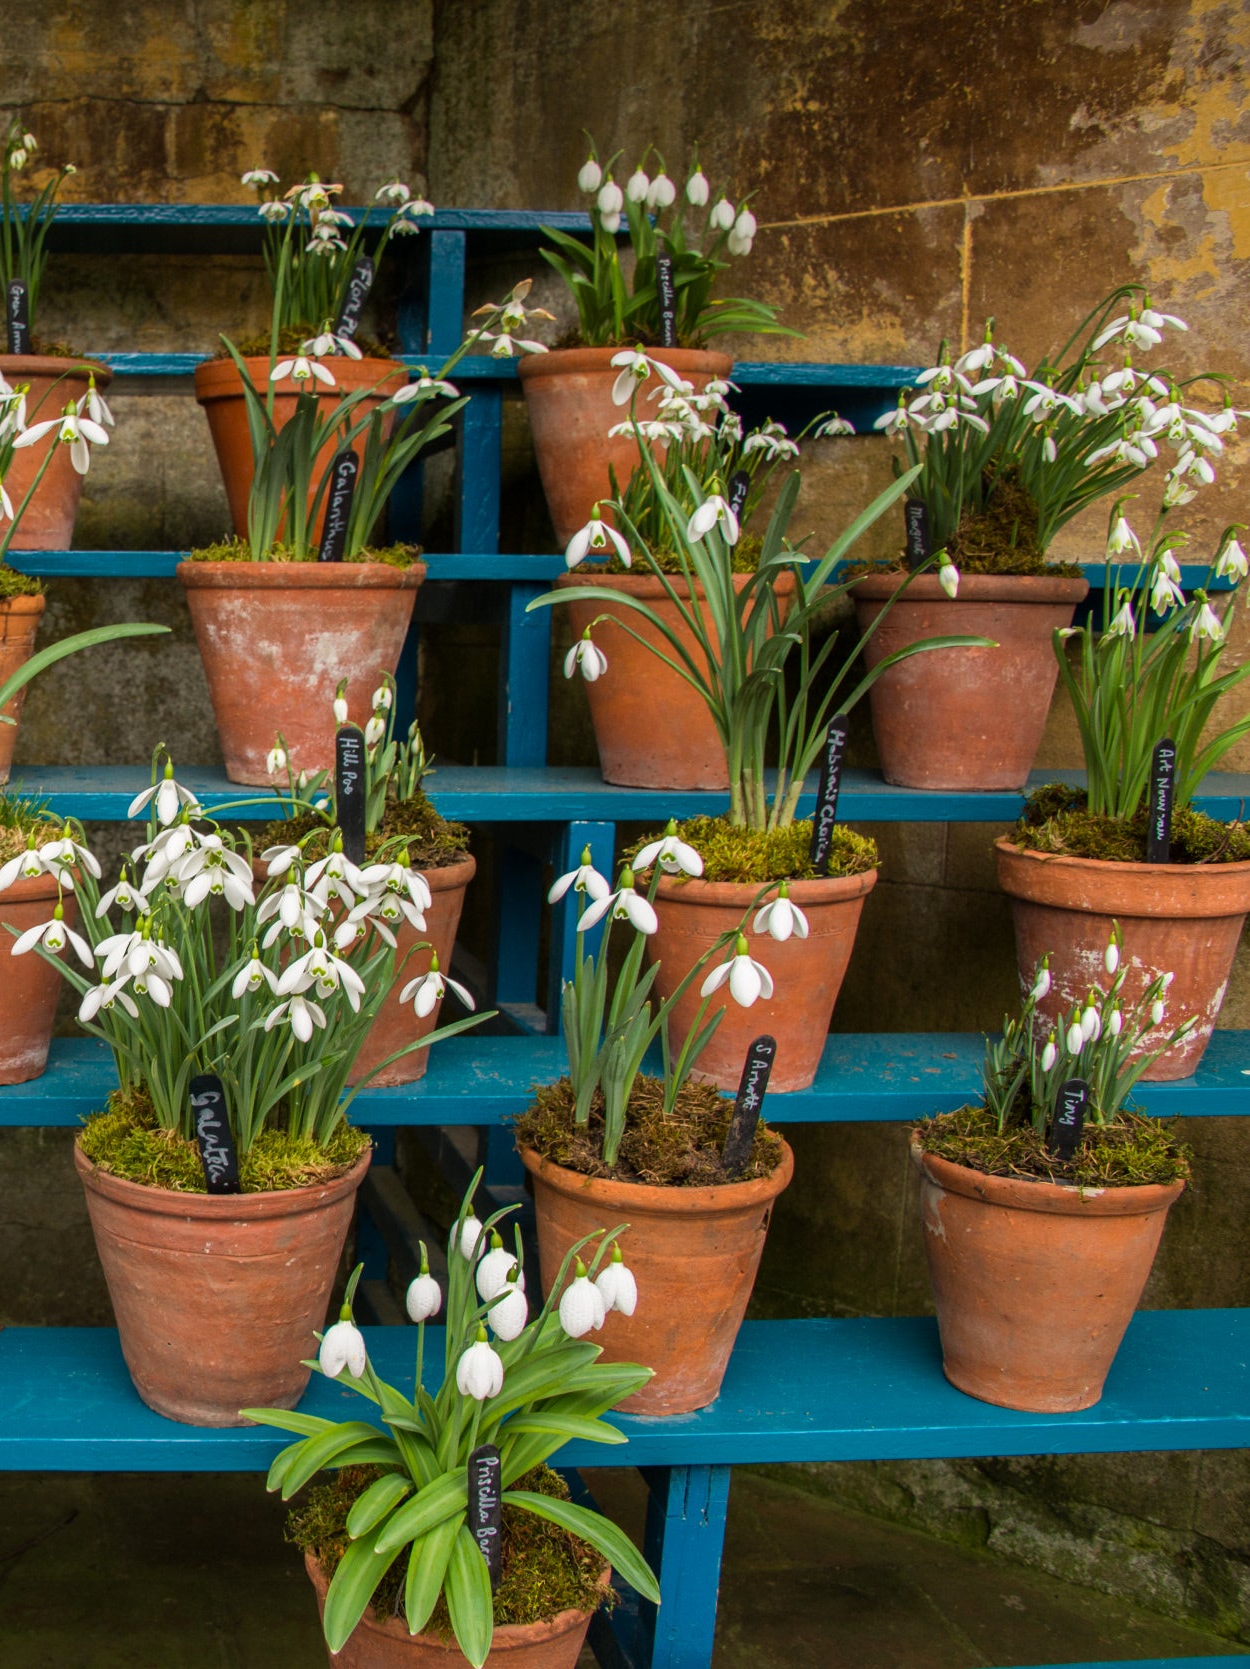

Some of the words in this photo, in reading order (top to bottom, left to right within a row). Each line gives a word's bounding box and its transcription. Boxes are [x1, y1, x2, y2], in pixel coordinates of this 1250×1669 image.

[911, 507, 925, 555] Magnet
[340, 737, 359, 770] Hill
[1160, 749, 1174, 773] Art
[742, 1061, 768, 1109] Arnott
[1058, 1090, 1084, 1126] Tiny
[191, 1091, 229, 1183] Galatea
[477, 1457, 498, 1522] Priscilla
